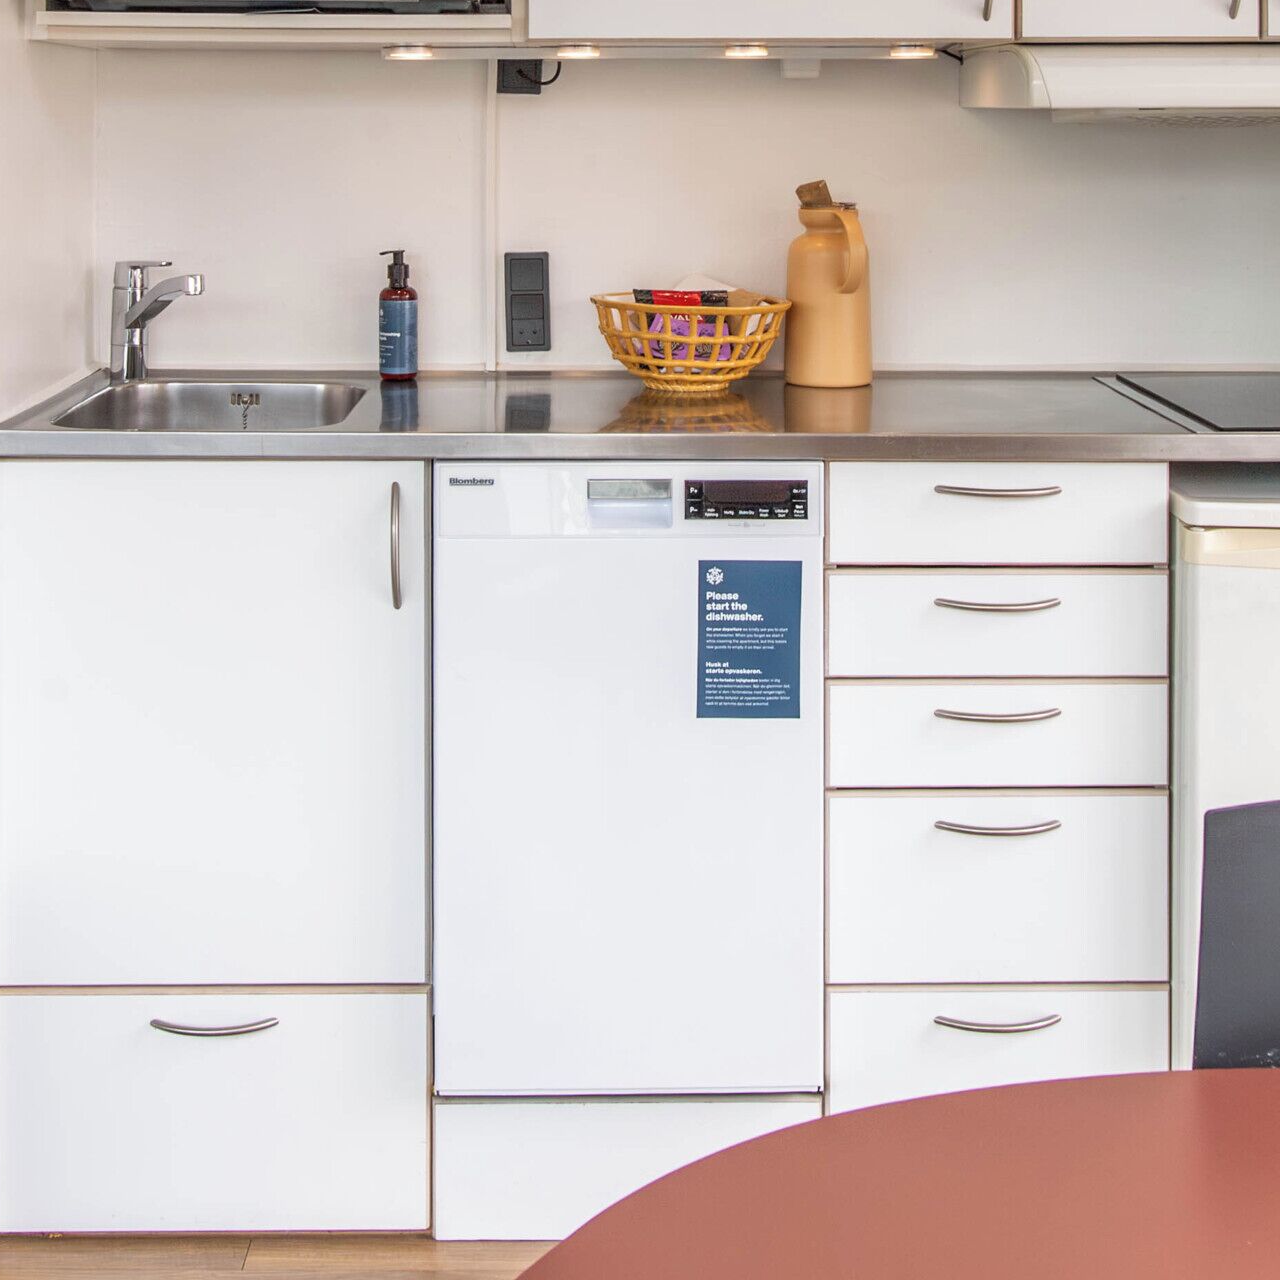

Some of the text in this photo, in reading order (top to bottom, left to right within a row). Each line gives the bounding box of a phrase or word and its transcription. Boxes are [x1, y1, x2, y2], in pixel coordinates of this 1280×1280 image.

[449, 477, 495, 487] Blomberg
[706, 591, 739, 601] Please
[705, 601, 748, 611] start the
[705, 611, 764, 622] dishwasher.
